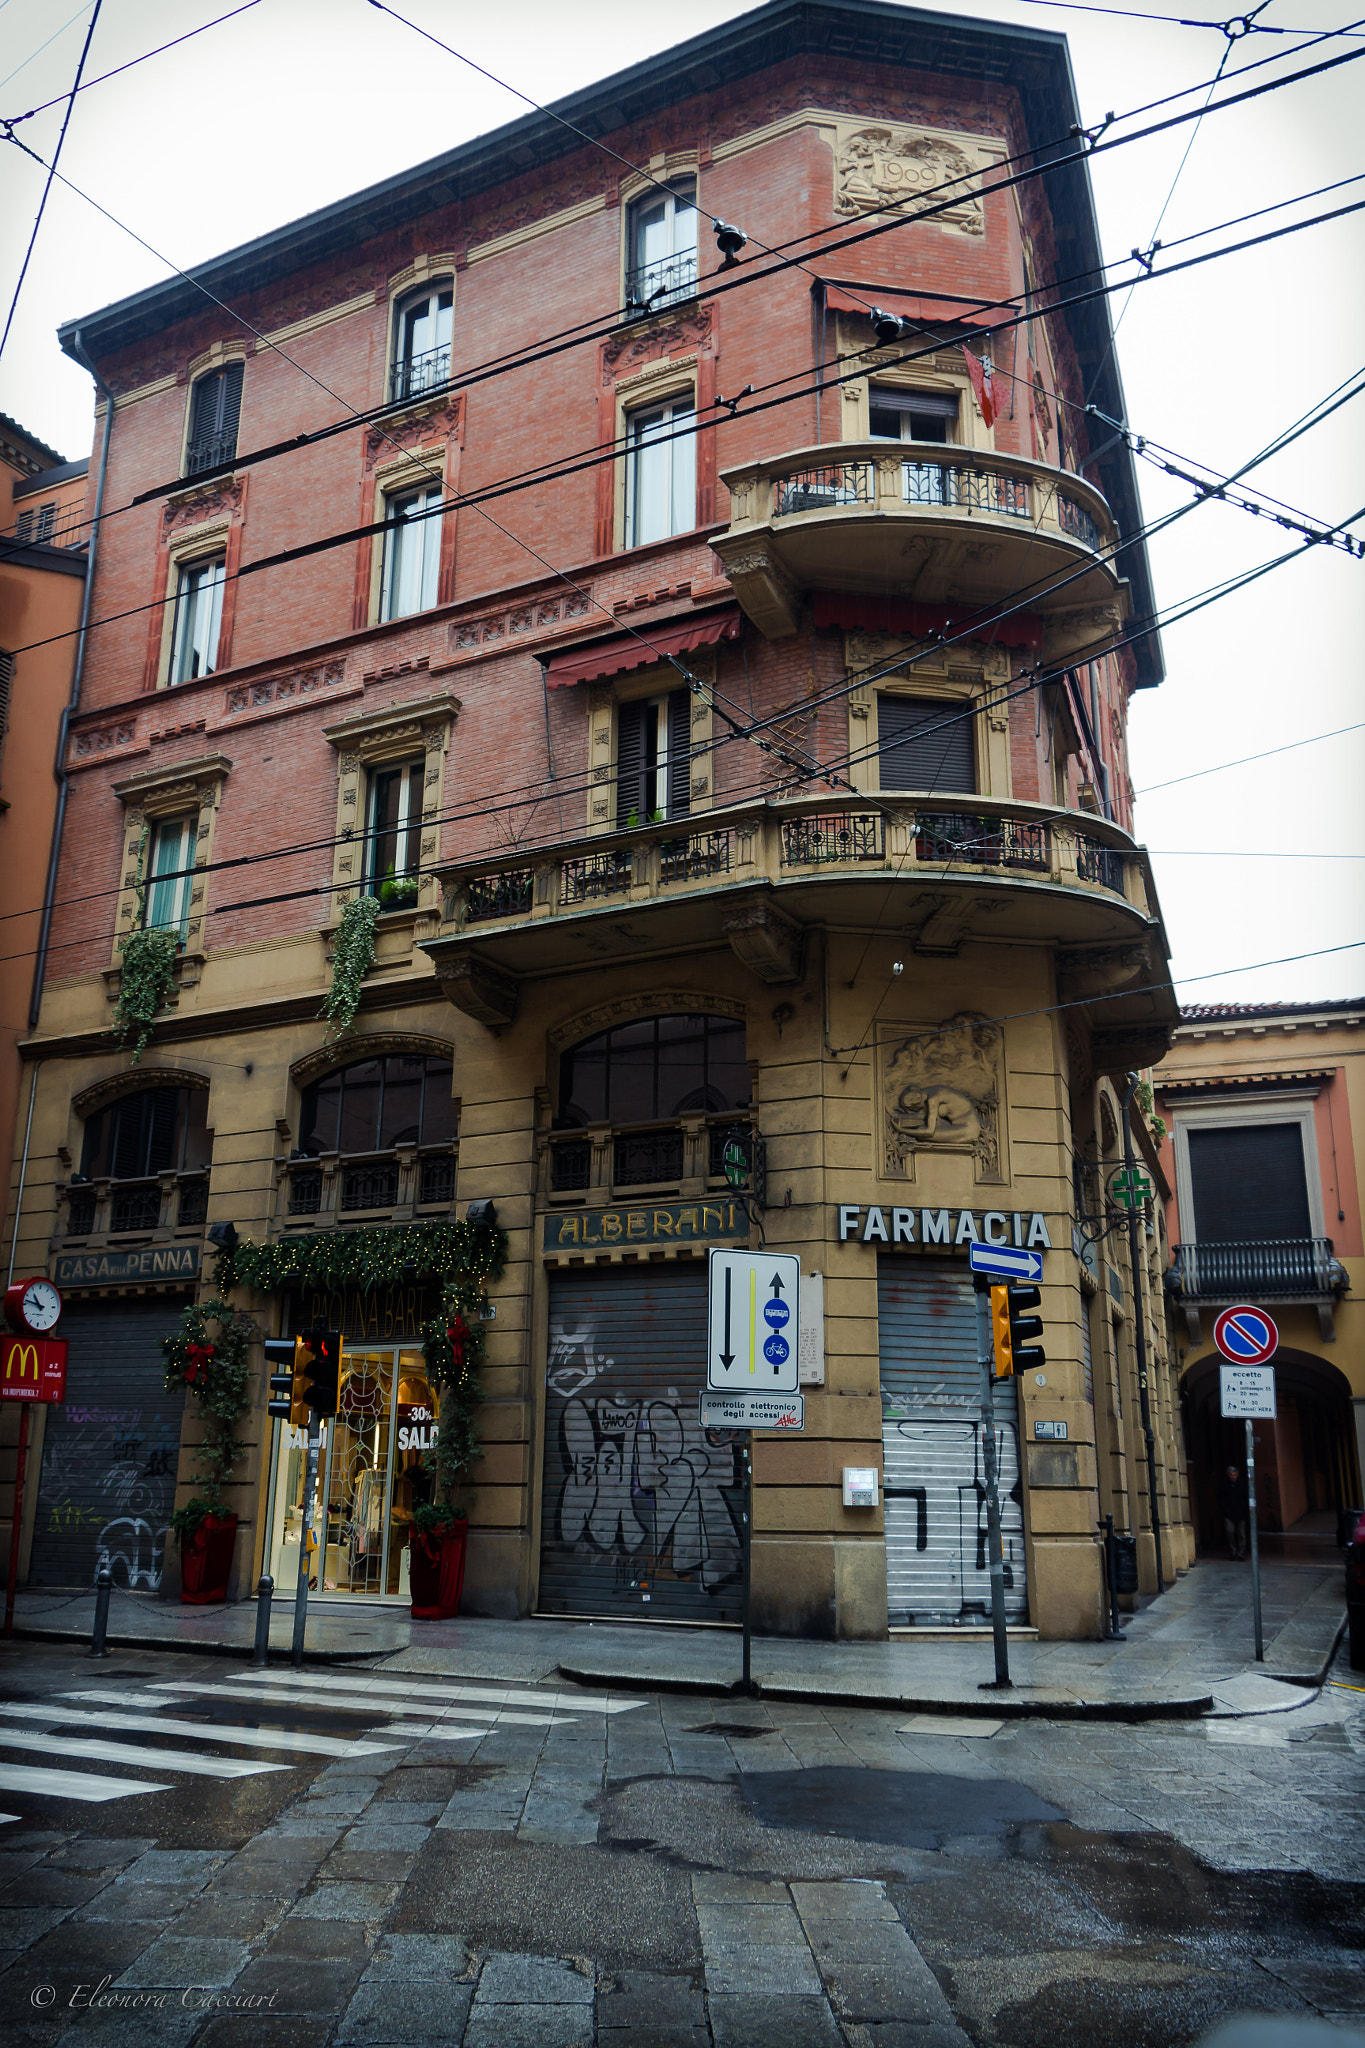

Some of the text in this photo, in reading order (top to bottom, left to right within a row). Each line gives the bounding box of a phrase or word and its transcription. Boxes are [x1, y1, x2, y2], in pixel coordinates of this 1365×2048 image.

[882, 161, 938, 188] 1909
[557, 1203, 737, 1245] ALBERANI
[838, 1205, 1052, 1248] FARMACIA
[60, 1256, 110, 1280] CASA
[126, 1248, 194, 1275] PENNA
[311, 1289, 379, 1340] PAOLINA
[407, 1406, 432, 1422] -30%
[706, 1401, 797, 1411] controllo elettronico
[723, 1409, 744, 1419] degli
[749, 1411, 780, 1419] accessi
[282, 1427, 328, 1449] SALI
